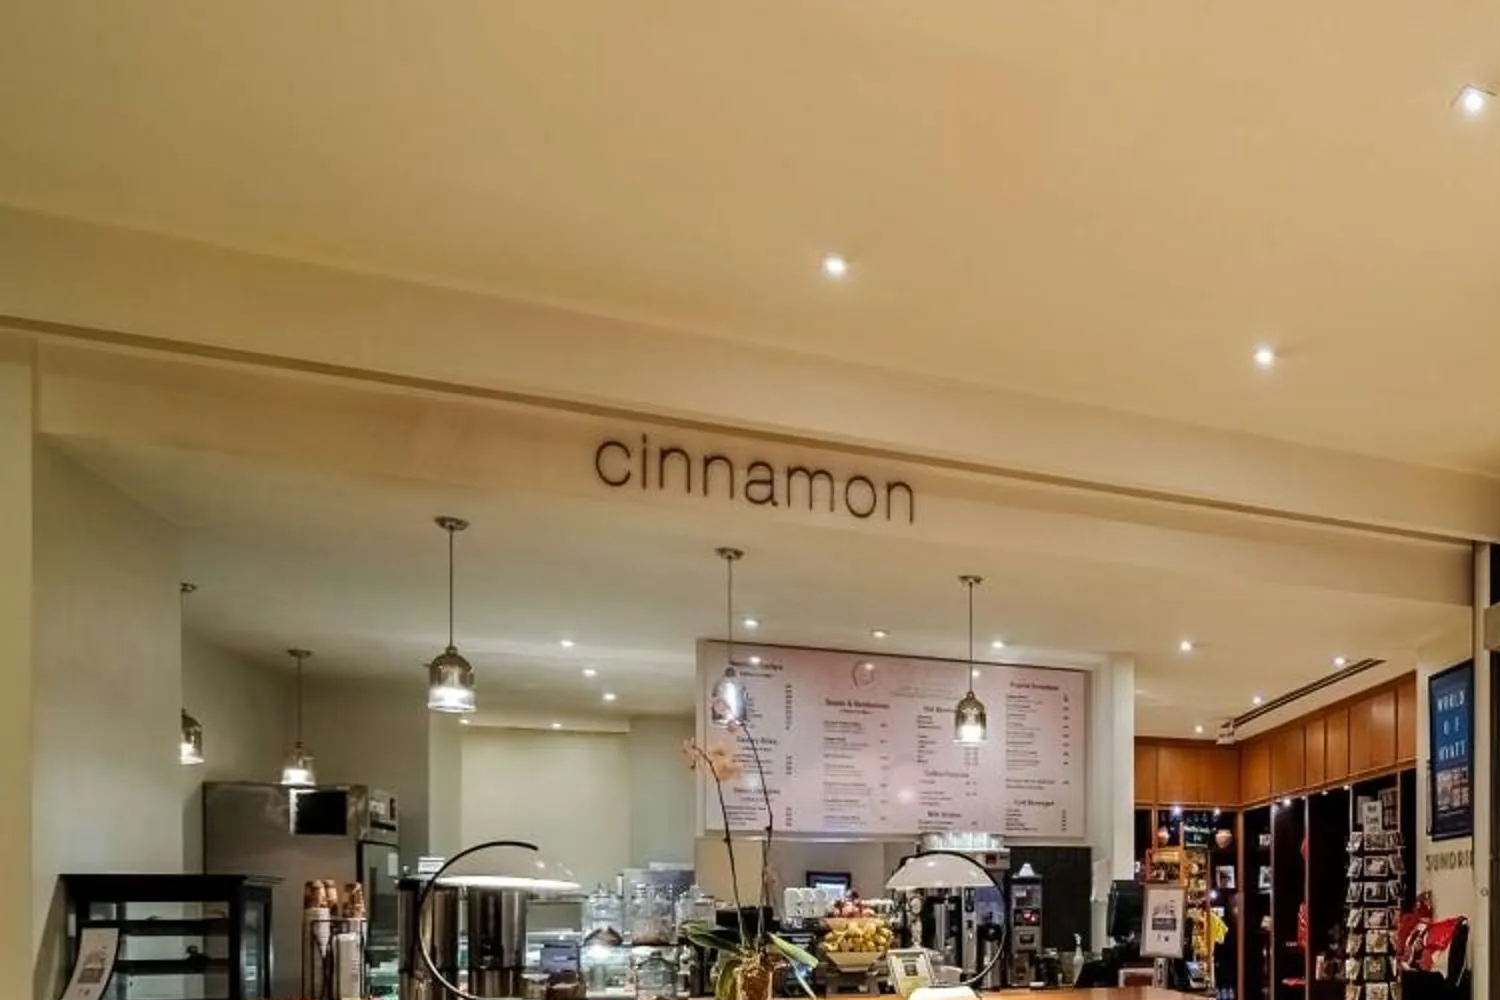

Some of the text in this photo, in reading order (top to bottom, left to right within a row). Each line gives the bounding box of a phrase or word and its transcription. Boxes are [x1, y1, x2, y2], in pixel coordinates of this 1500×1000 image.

[595, 434, 914, 524] cinnamon
[1437, 690, 1465, 712] WORLD
[1443, 716, 1460, 735] OF
[1439, 741, 1465, 761] HYATT
